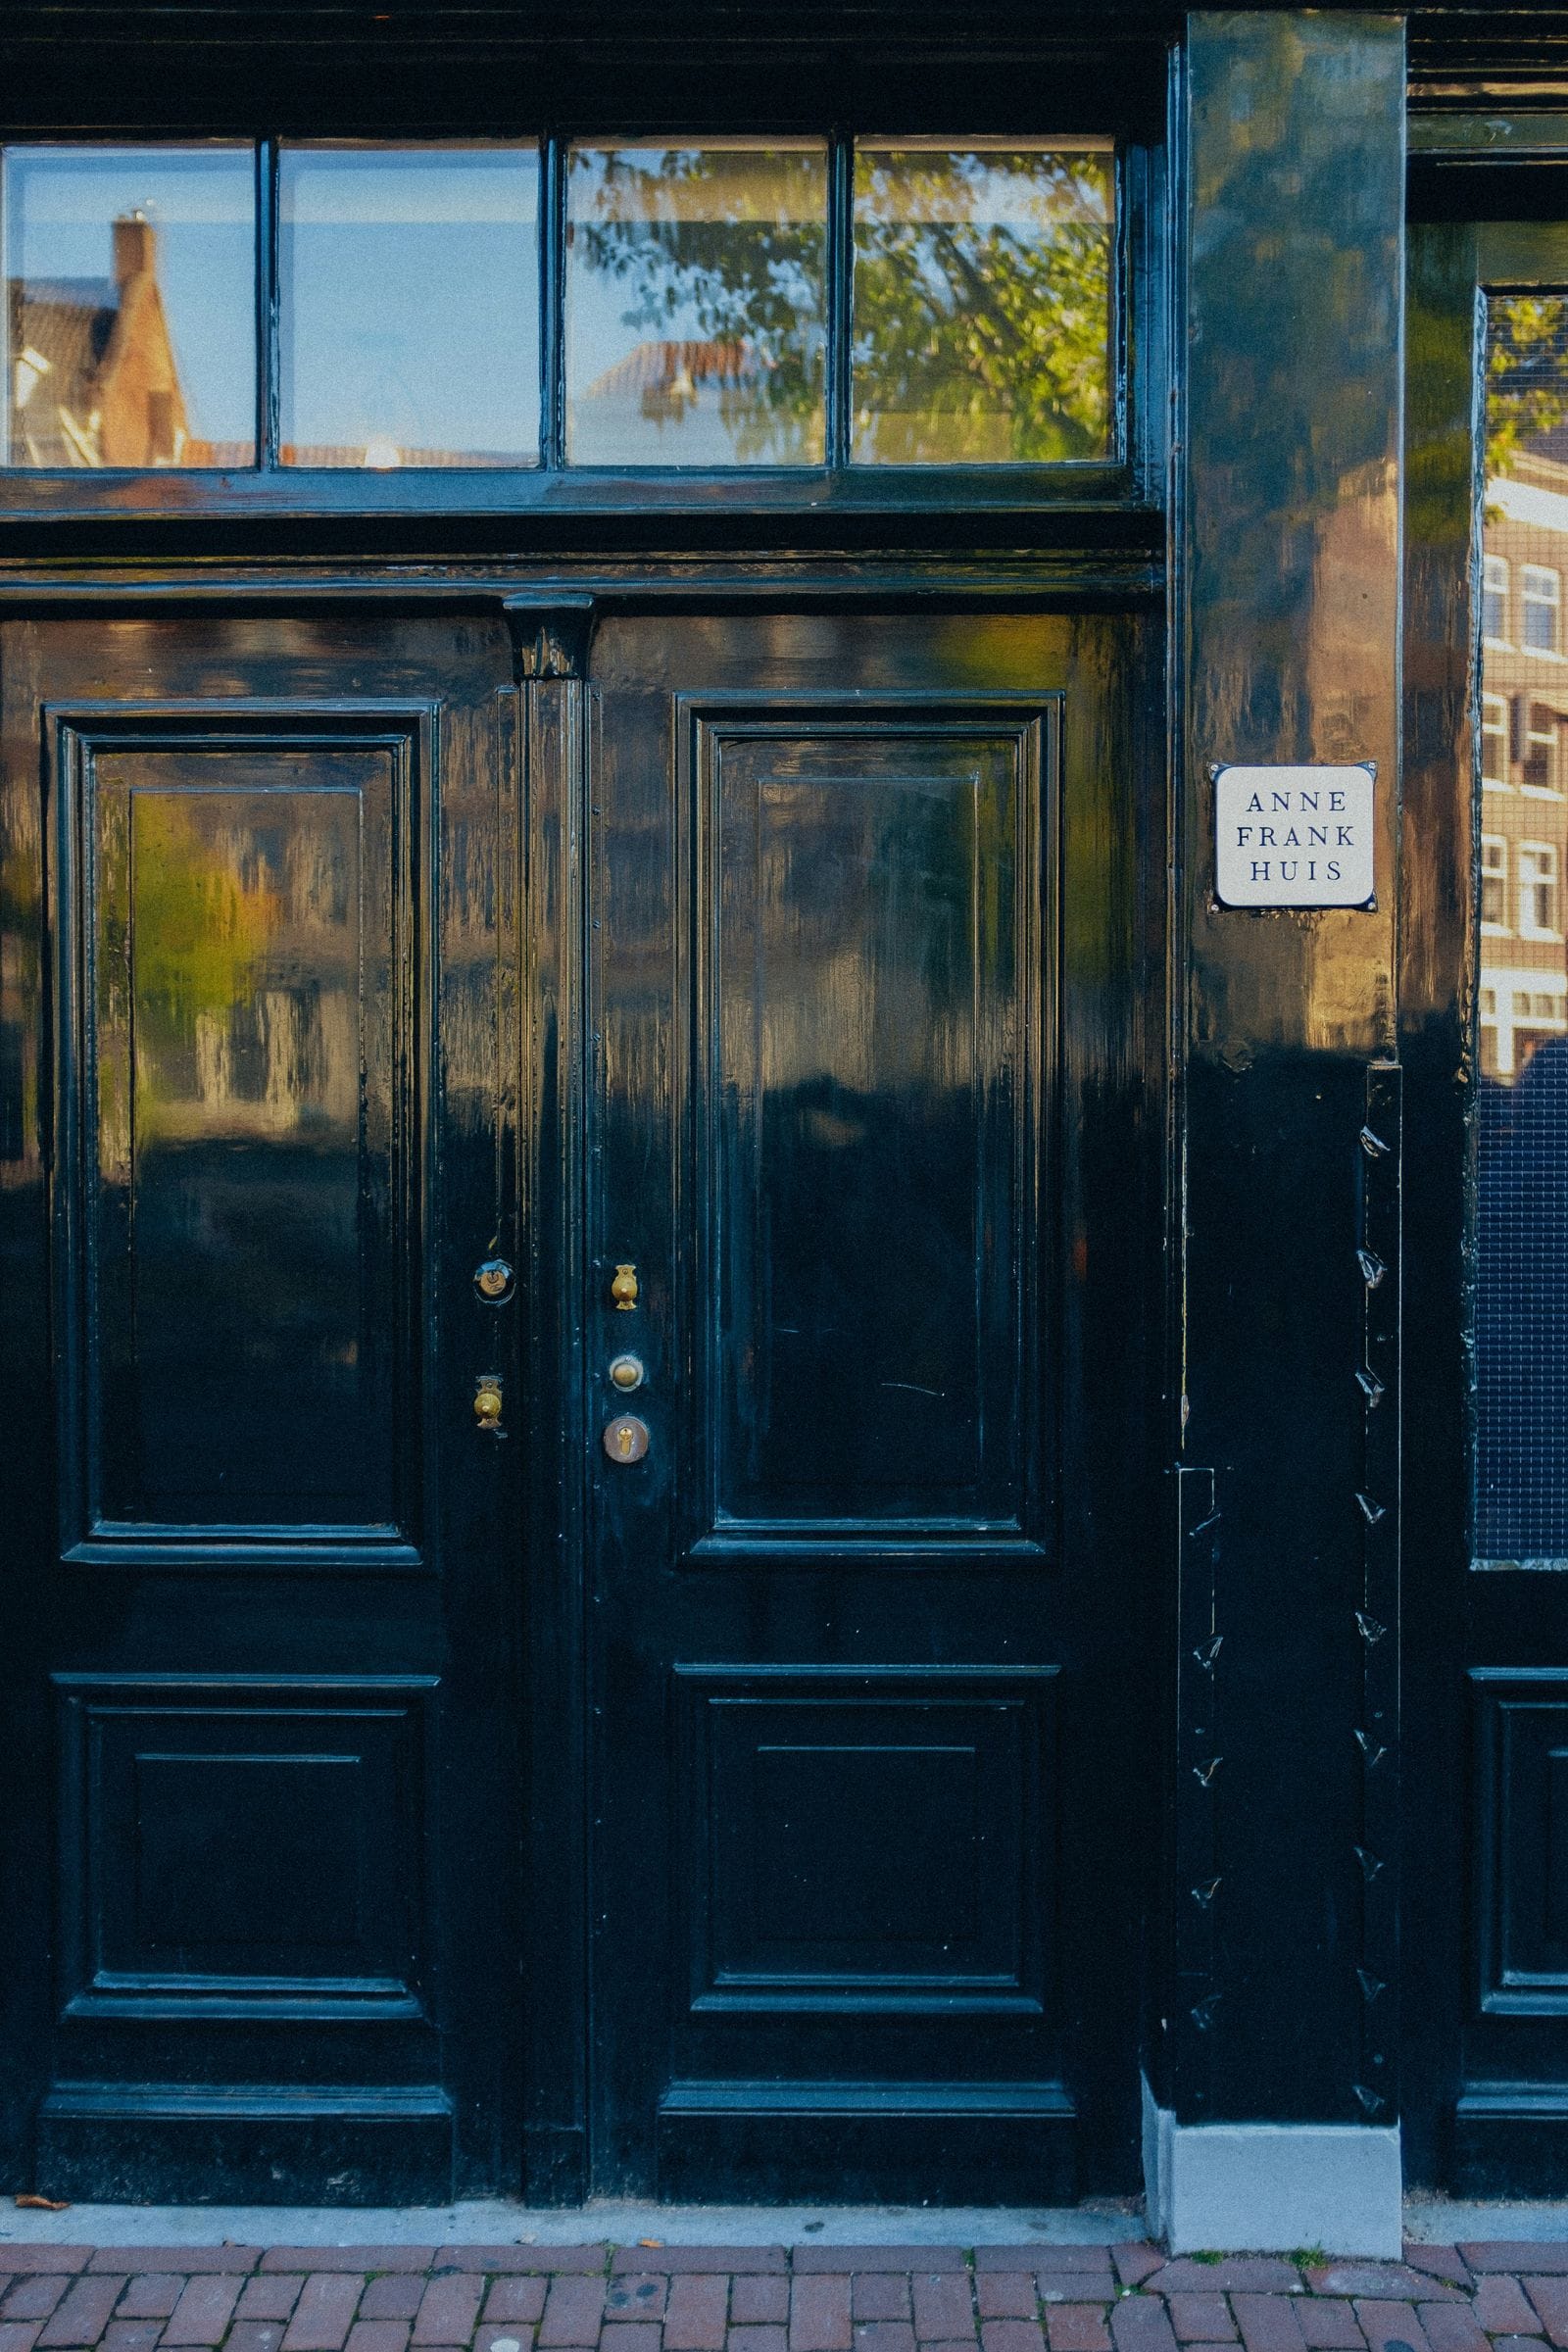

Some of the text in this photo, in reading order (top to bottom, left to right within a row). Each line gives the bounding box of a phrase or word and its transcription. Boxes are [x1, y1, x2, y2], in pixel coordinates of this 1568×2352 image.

[1246, 791, 1347, 812] ANNE
[1236, 826, 1354, 847] FRANK
[1250, 860, 1342, 881] HUIS
